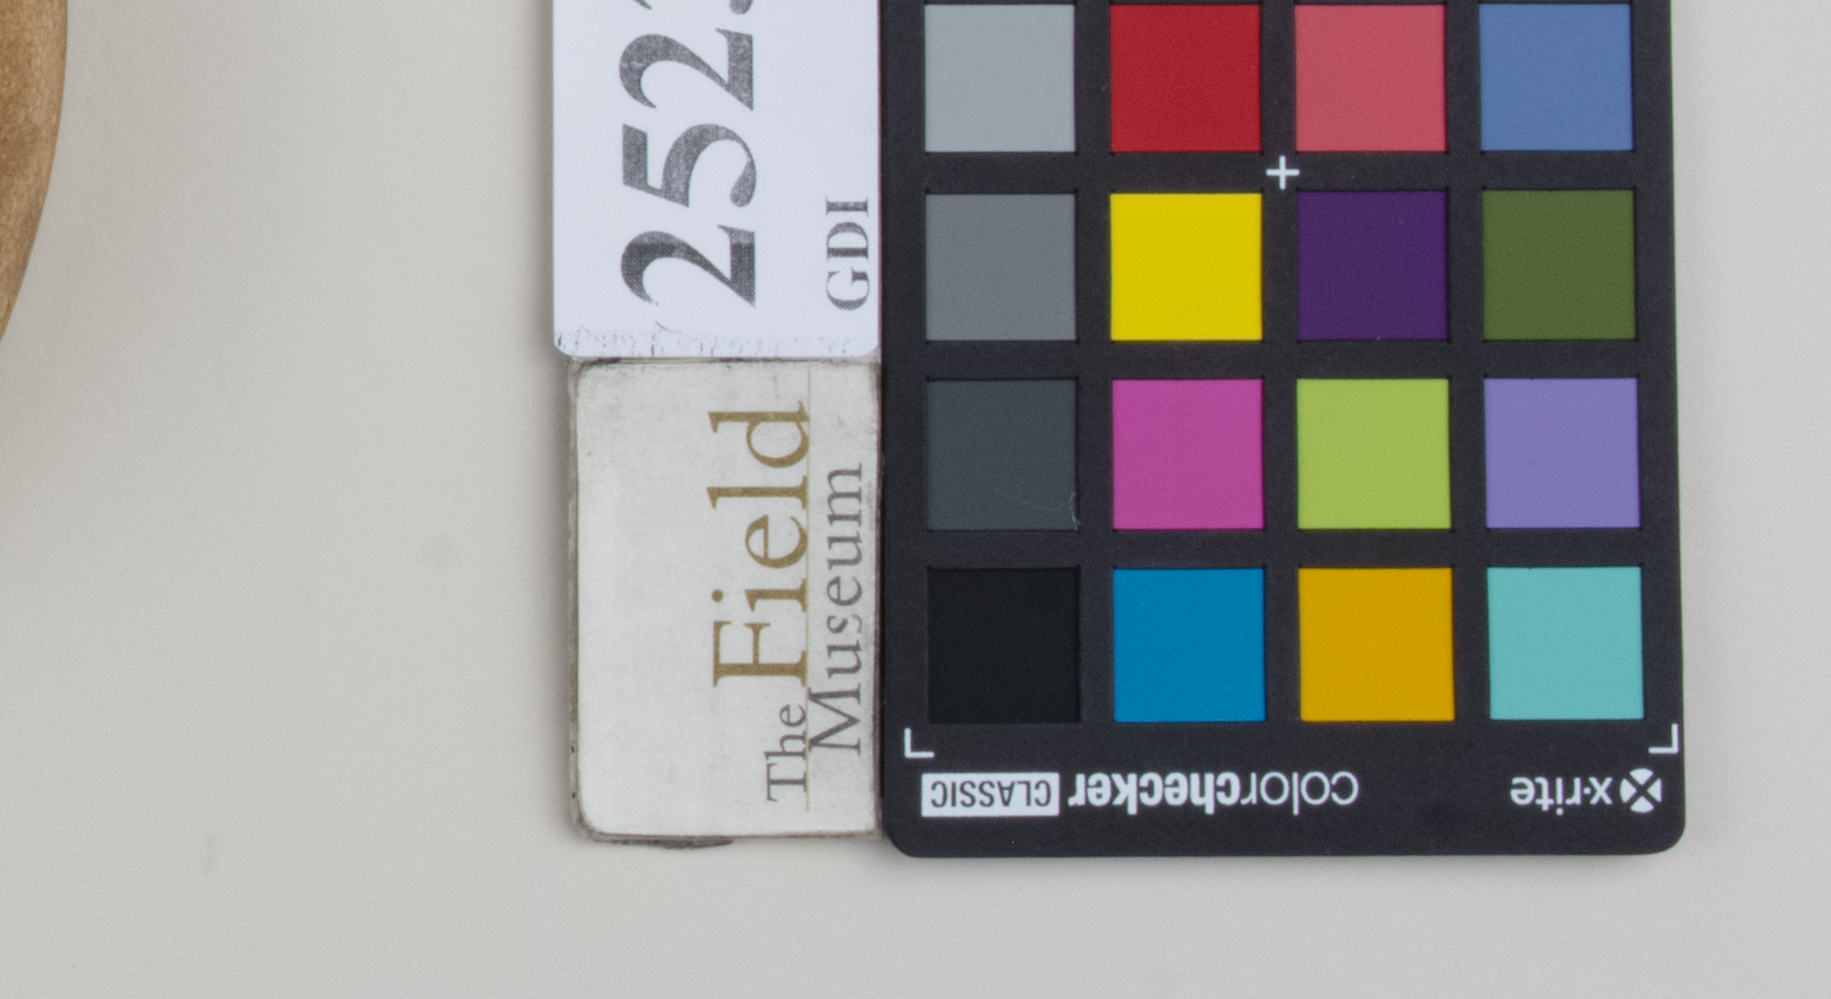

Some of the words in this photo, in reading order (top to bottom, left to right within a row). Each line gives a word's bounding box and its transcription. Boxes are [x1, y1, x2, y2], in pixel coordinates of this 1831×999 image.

[825, 197, 869, 310] GDI
[707, 401, 810, 687] Field
[808, 463, 863, 756] Museum
[764, 703, 806, 801] The
[930, 779, 1051, 809] CLASSIC
[1068, 771, 1358, 815] colorchecker
